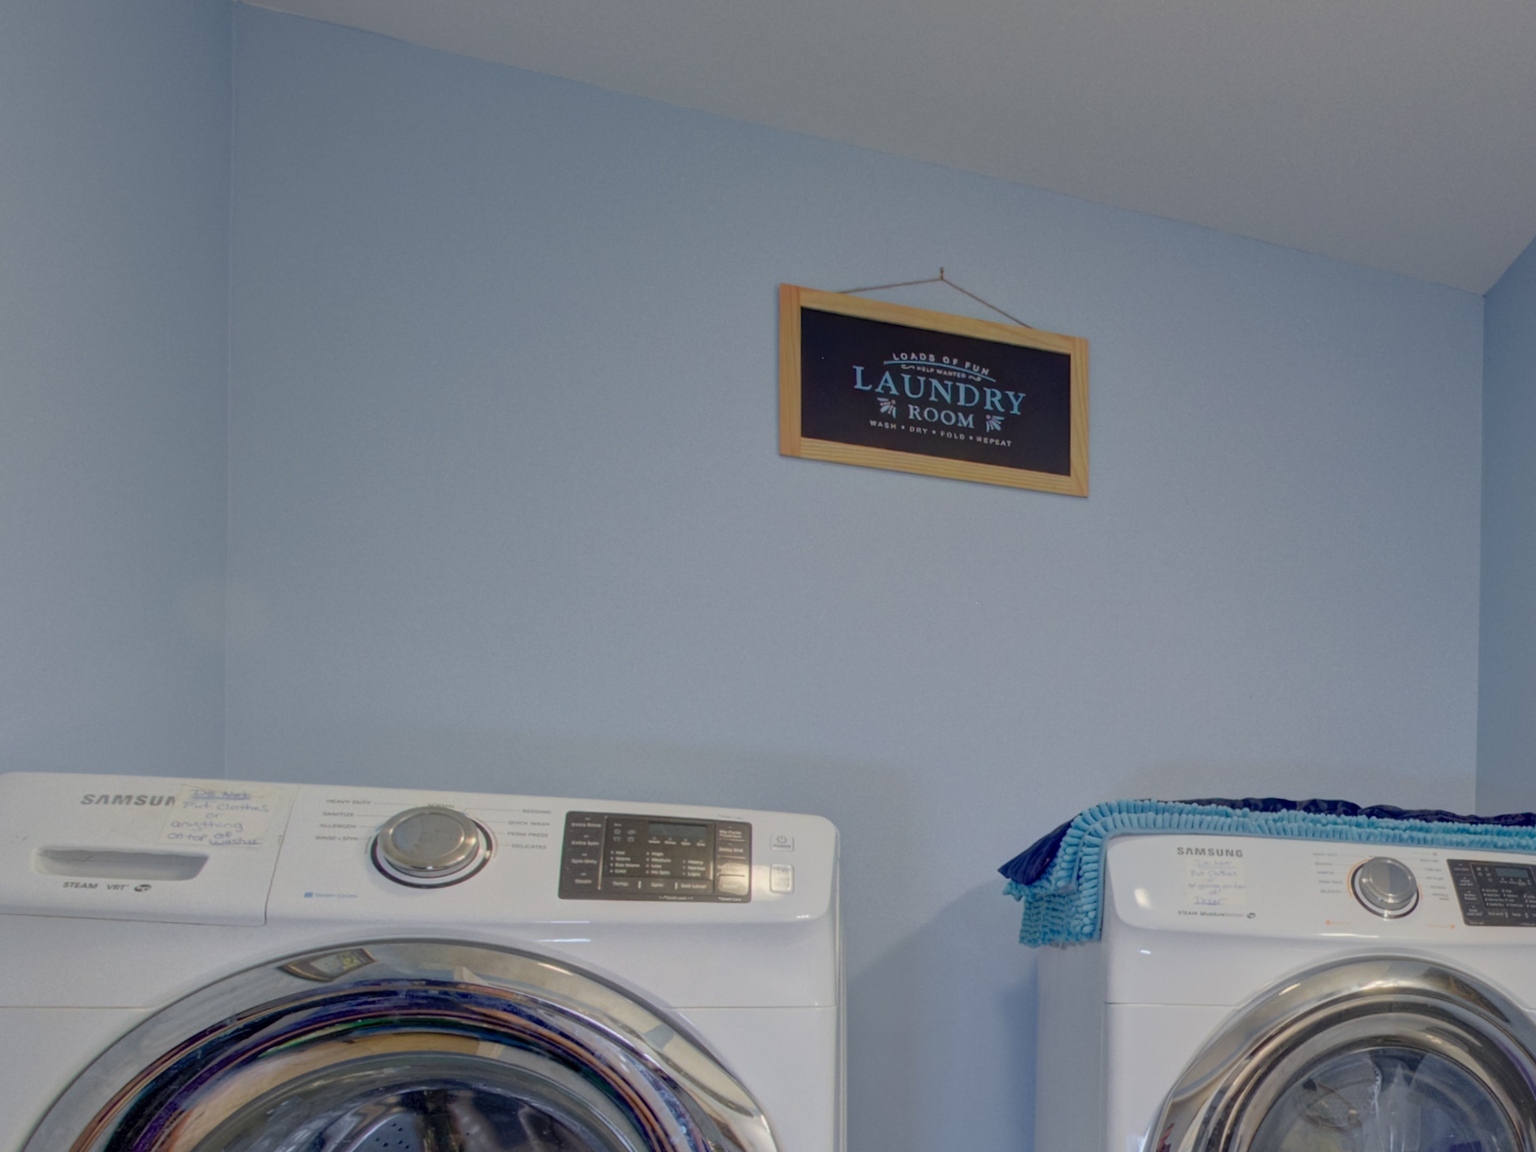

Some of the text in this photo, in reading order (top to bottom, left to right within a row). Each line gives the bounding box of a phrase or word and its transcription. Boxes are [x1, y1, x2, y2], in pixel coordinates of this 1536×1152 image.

[892, 352, 990, 376] LOADS OF FUN
[936, 369, 967, 379] WANTED
[852, 366, 1026, 415] LAUNDRY
[907, 404, 975, 429] ROOM
[869, 419, 1012, 448] WASH DRY FOLD REPEAT
[80, 793, 176, 806] SAMSUN
[1176, 846, 1244, 858] SAMSUNG
[62, 881, 127, 891] STEAM VRT
